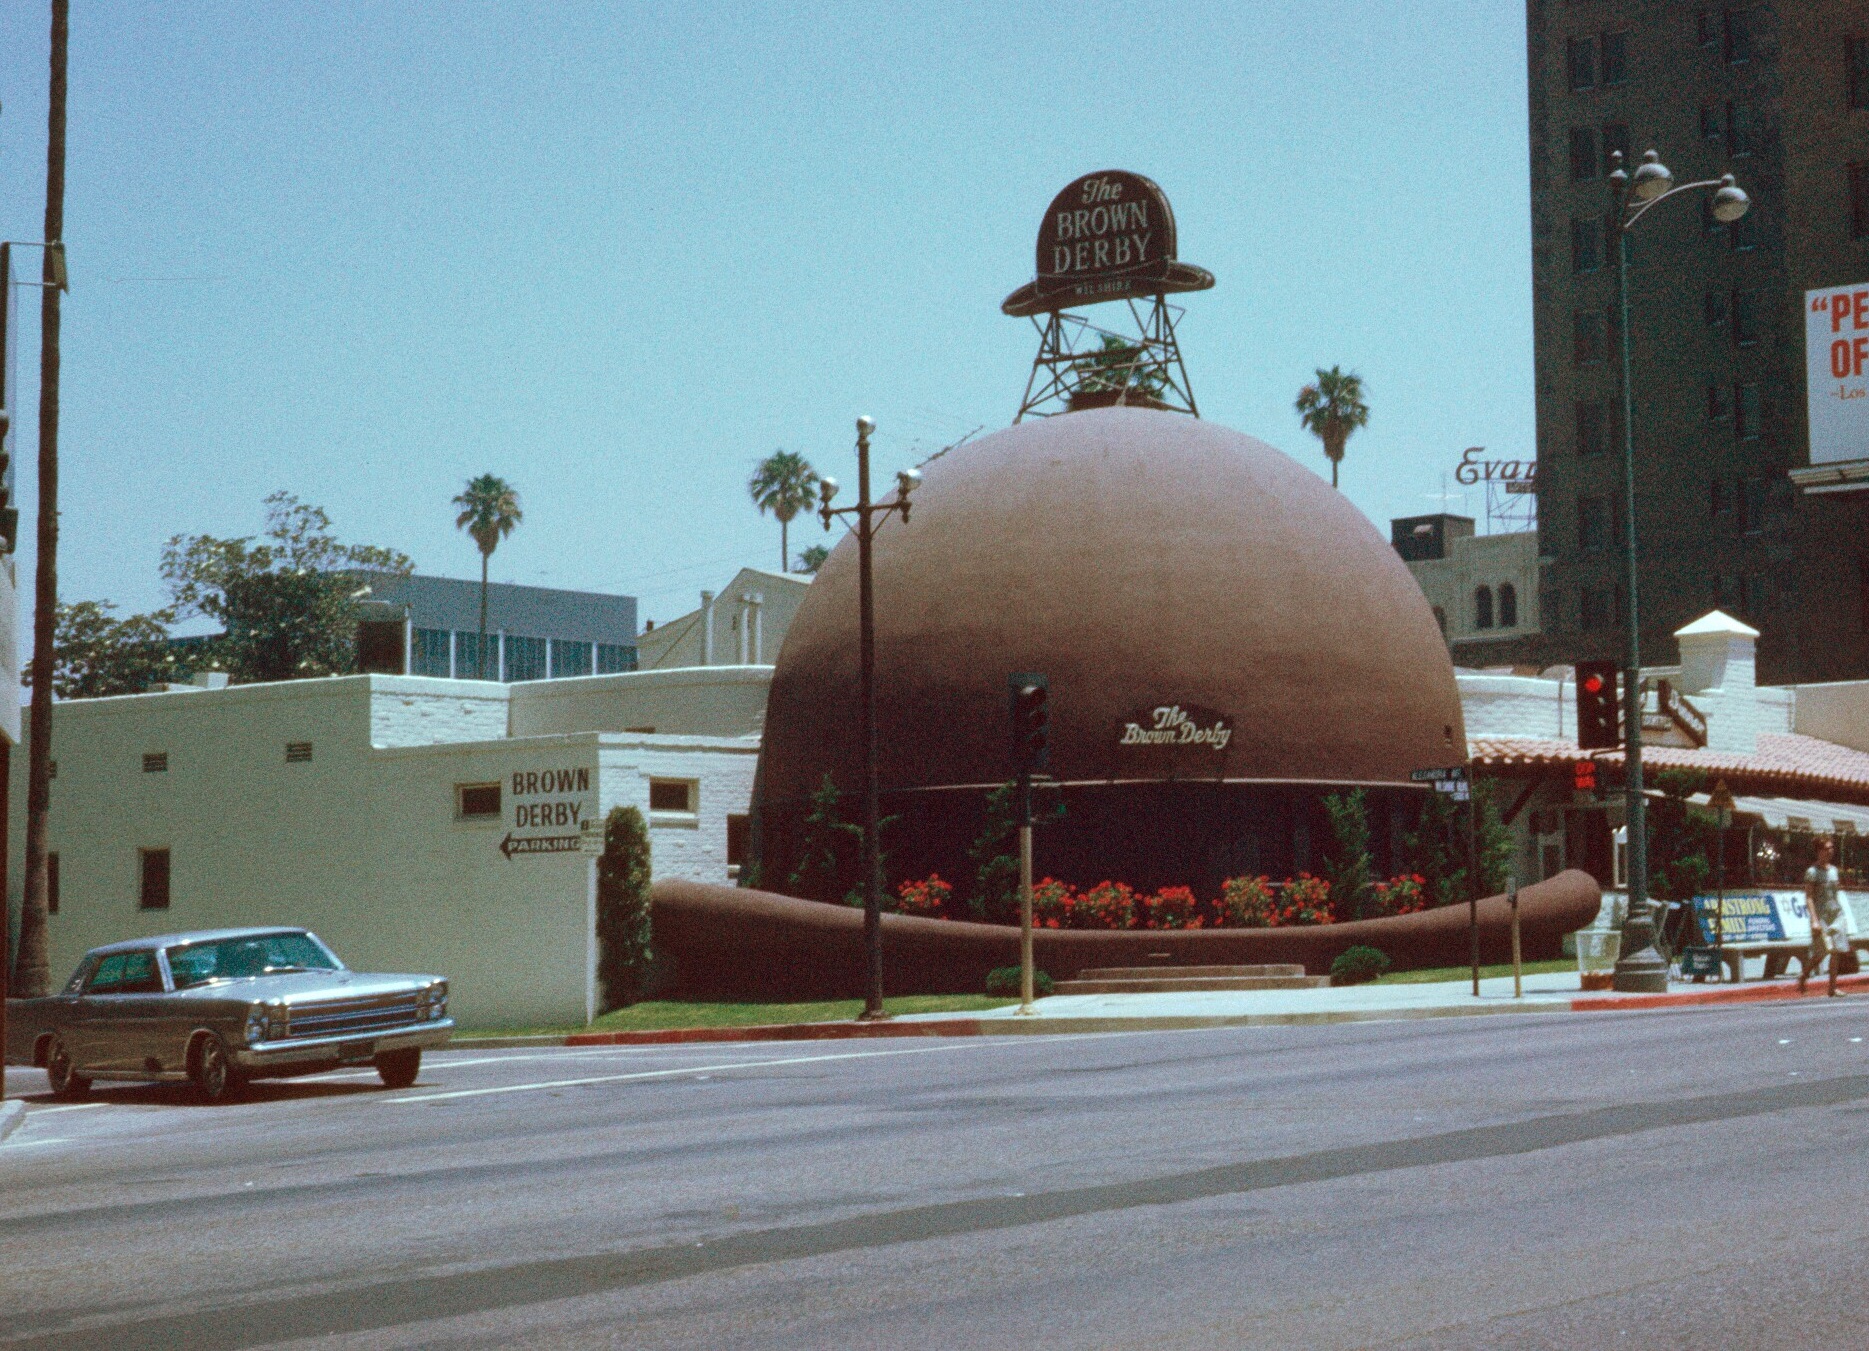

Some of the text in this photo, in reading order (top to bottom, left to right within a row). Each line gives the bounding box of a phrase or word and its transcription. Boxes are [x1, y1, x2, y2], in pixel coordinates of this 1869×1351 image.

[1082, 177, 1121, 203] The
[1058, 201, 1148, 241] BROWN
[1054, 234, 1149, 273] DERBY
[1830, 337, 1869, 379] OF
[1152, 705, 1187, 729] The
[1120, 721, 1231, 750] Brown Derby
[513, 769, 589, 795] BROWN
[516, 802, 581, 828] DERBY
